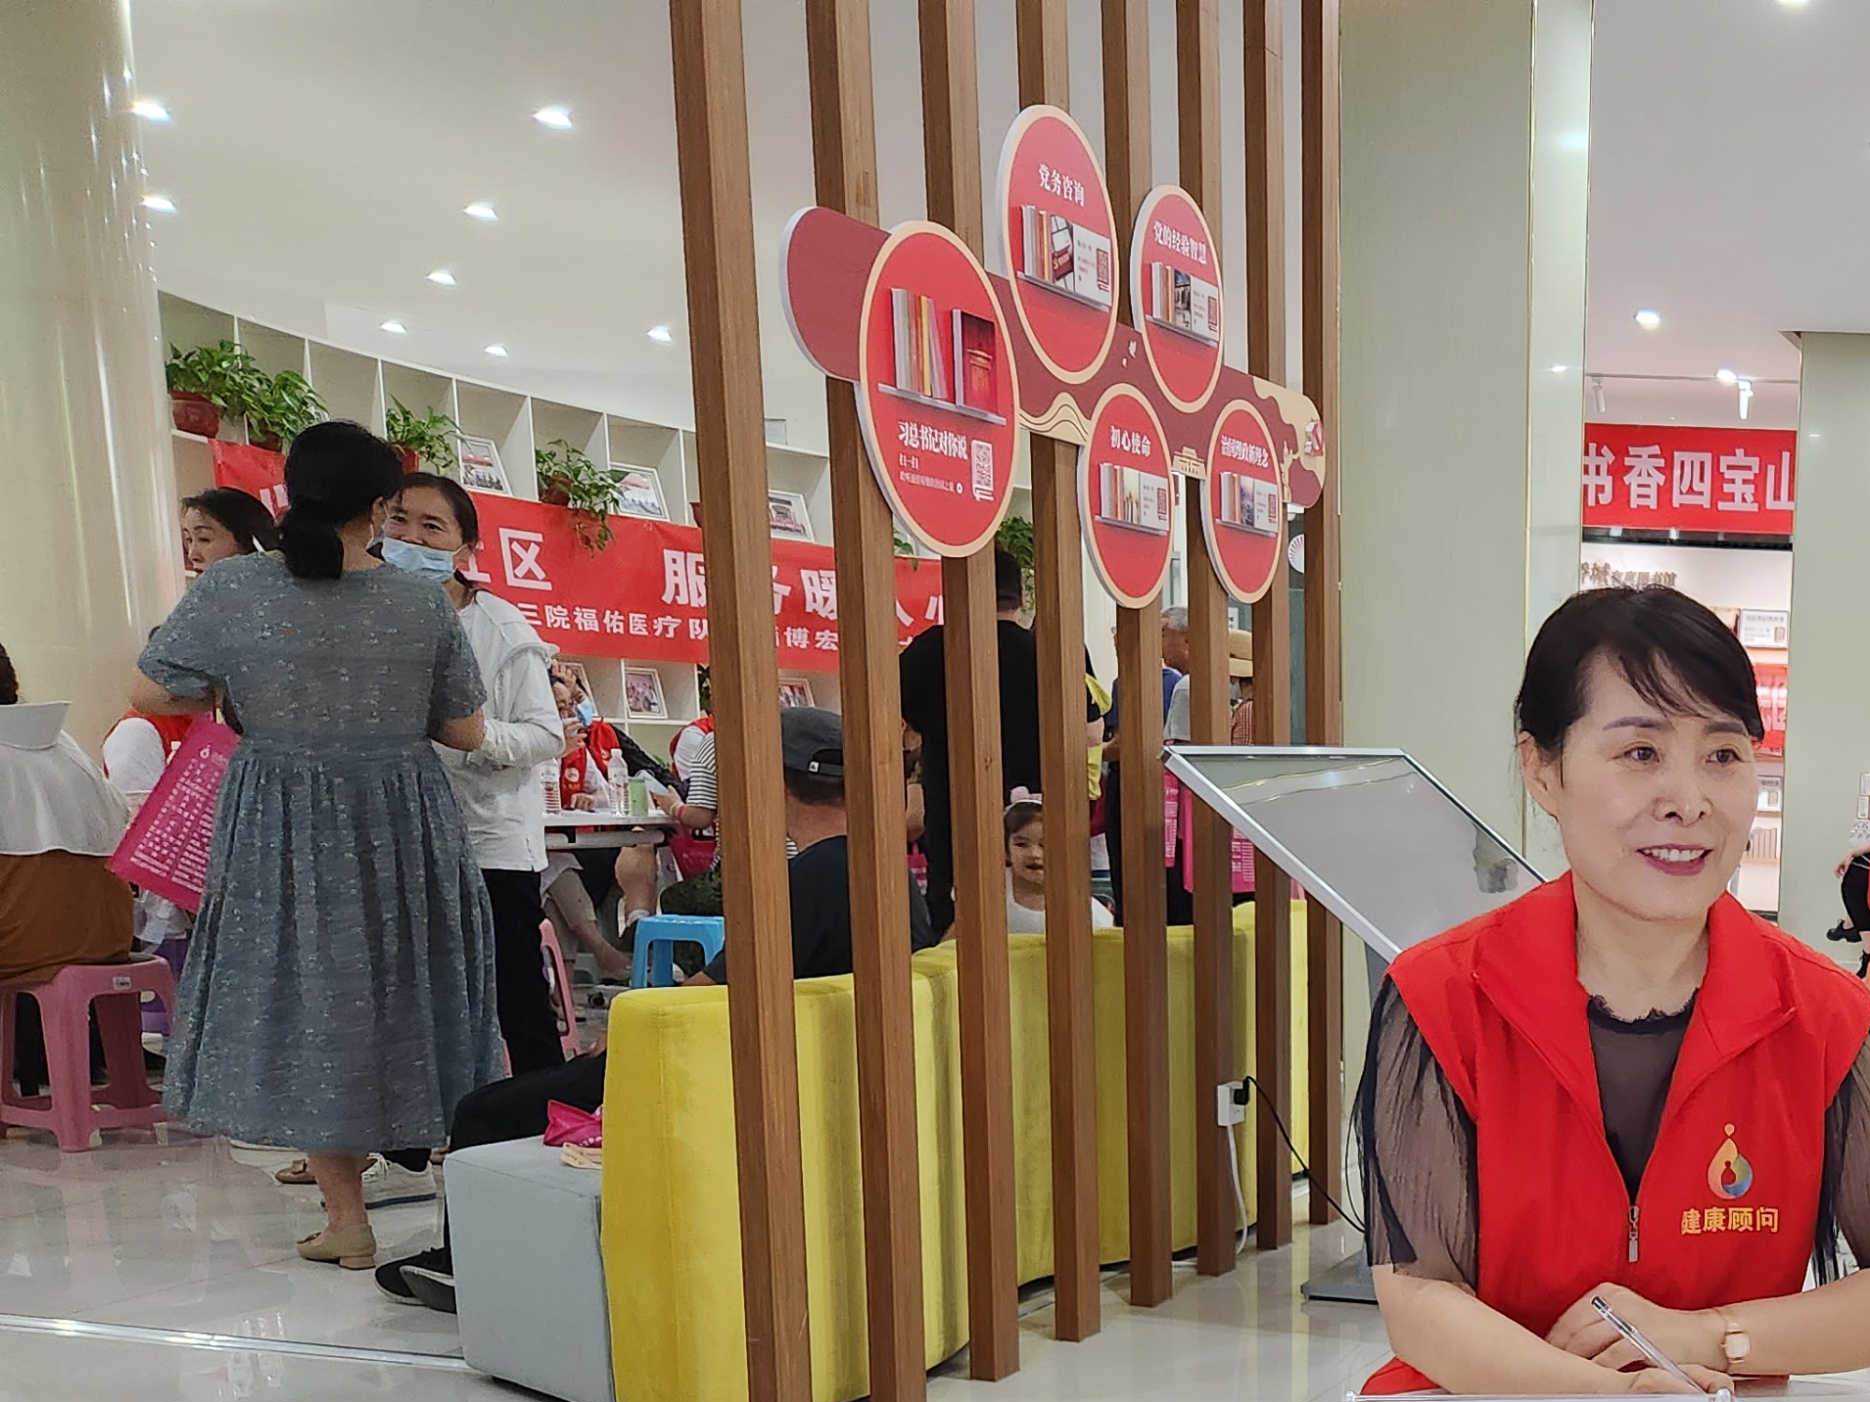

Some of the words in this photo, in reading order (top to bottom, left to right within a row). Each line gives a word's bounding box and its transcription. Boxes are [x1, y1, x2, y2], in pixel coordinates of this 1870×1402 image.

[1038, 163, 1085, 207] 党务咨询
[898, 421, 968, 460] 习总书记对你说
[1110, 425, 1151, 457] 初心使命
[1583, 443, 1795, 512] 书香四宝山
[1681, 1207, 1779, 1235] 健康顾问
